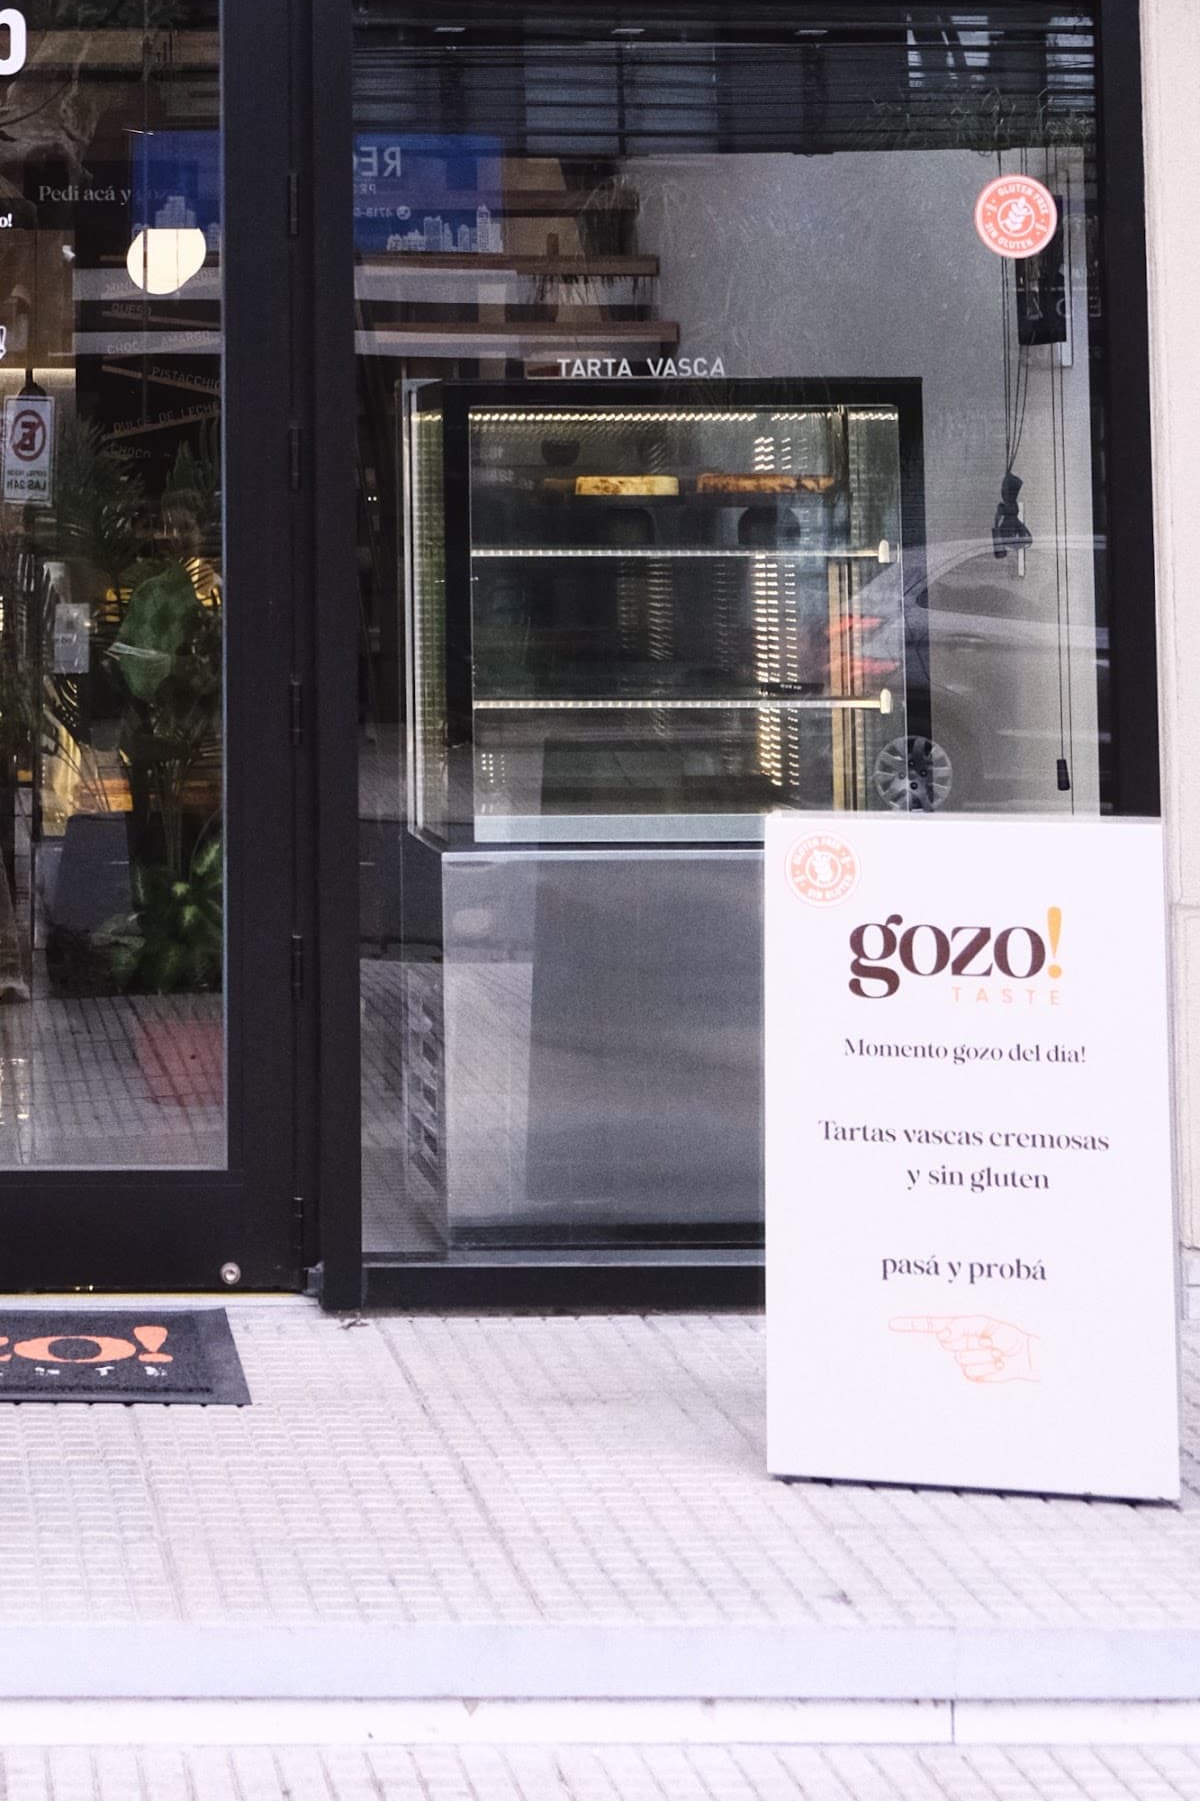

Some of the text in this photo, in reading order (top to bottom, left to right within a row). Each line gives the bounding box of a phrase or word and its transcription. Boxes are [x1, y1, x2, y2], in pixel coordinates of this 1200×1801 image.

[83, 185, 116, 202] acá
[119, 188, 132, 206] y
[556, 357, 725, 378] TARTA VASCA
[849, 906, 1063, 999] gozo!
[952, 986, 1060, 1006] TASTE
[845, 1038, 948, 1059] Momento
[953, 1043, 1004, 1065] gozo
[1008, 1043, 1041, 1062] del
[818, 1119, 1110, 1151] Tartas vascas cremosas
[906, 1164, 1050, 1193] y sin gluten
[882, 1255, 1047, 1285] pasá y probá
